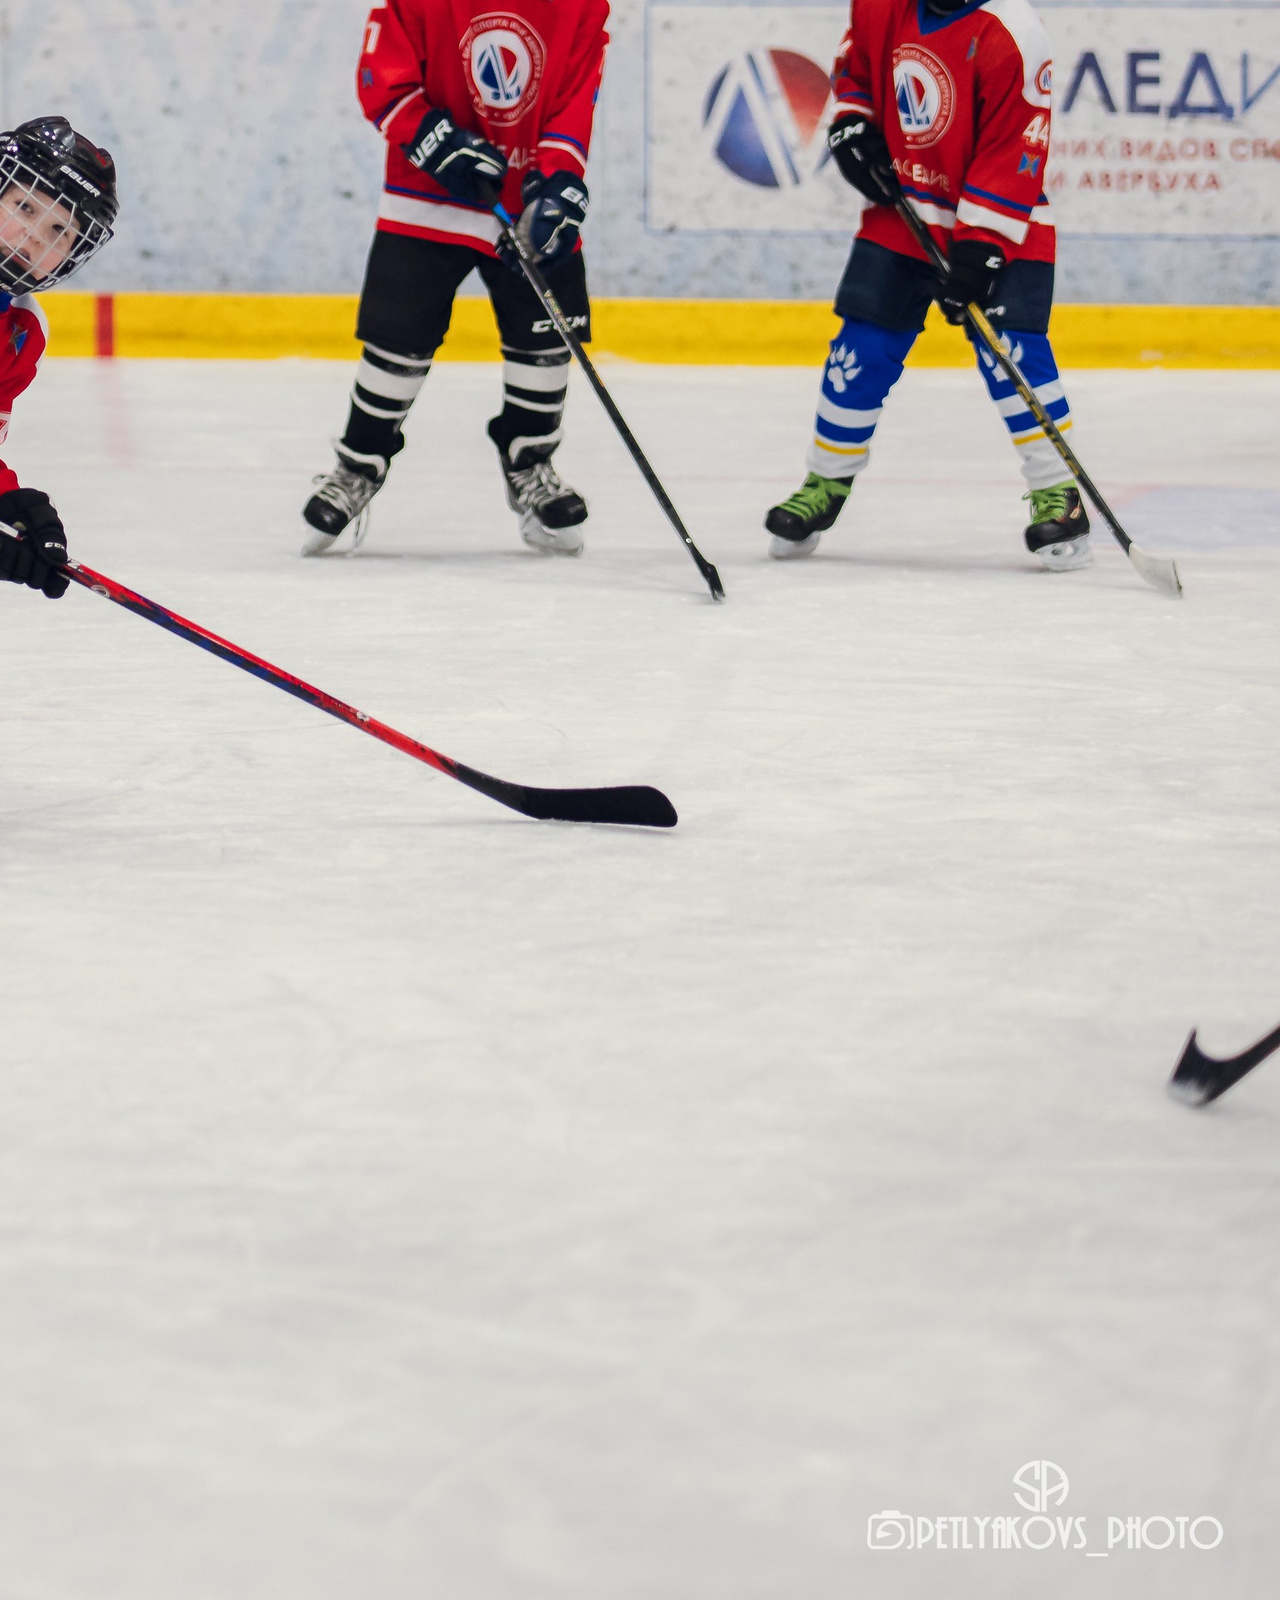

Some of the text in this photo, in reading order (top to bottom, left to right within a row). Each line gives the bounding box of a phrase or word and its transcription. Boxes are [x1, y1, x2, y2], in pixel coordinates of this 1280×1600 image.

[409, 117, 454, 168] UER
[1121, 138, 1220, 162] ВИДОВ
[59, 164, 101, 198] BAUER
[1076, 170, 1222, 191] АВЕРБУХА
